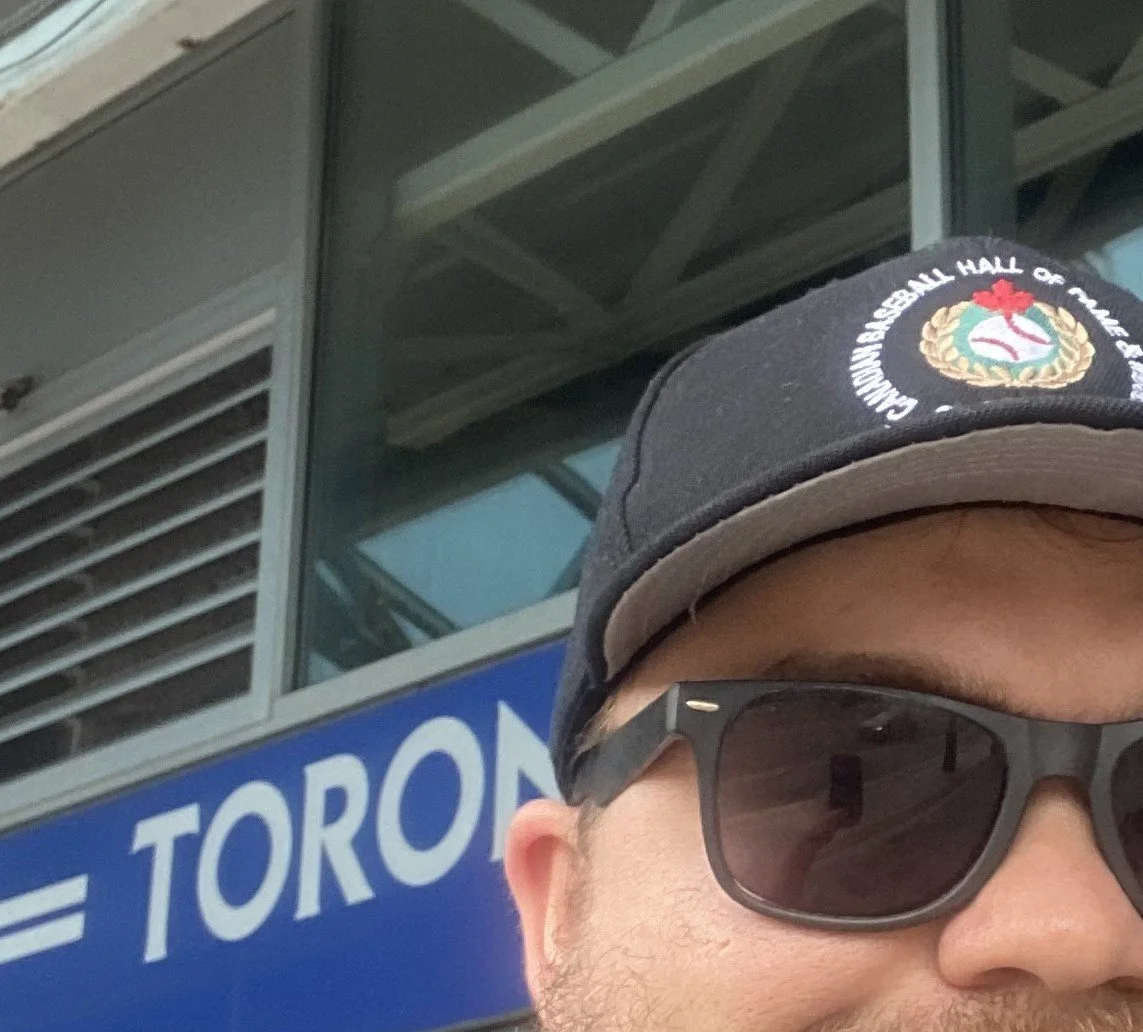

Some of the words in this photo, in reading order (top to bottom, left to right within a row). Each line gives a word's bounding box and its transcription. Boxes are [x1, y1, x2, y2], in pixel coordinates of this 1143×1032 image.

[957, 256, 1024, 275] HALL
[1033, 267, 1066, 286] OF
[856, 267, 955, 344] BASEBALL
[1115, 340, 1143, 359] &
[849, 342, 919, 421] CANADIAN
